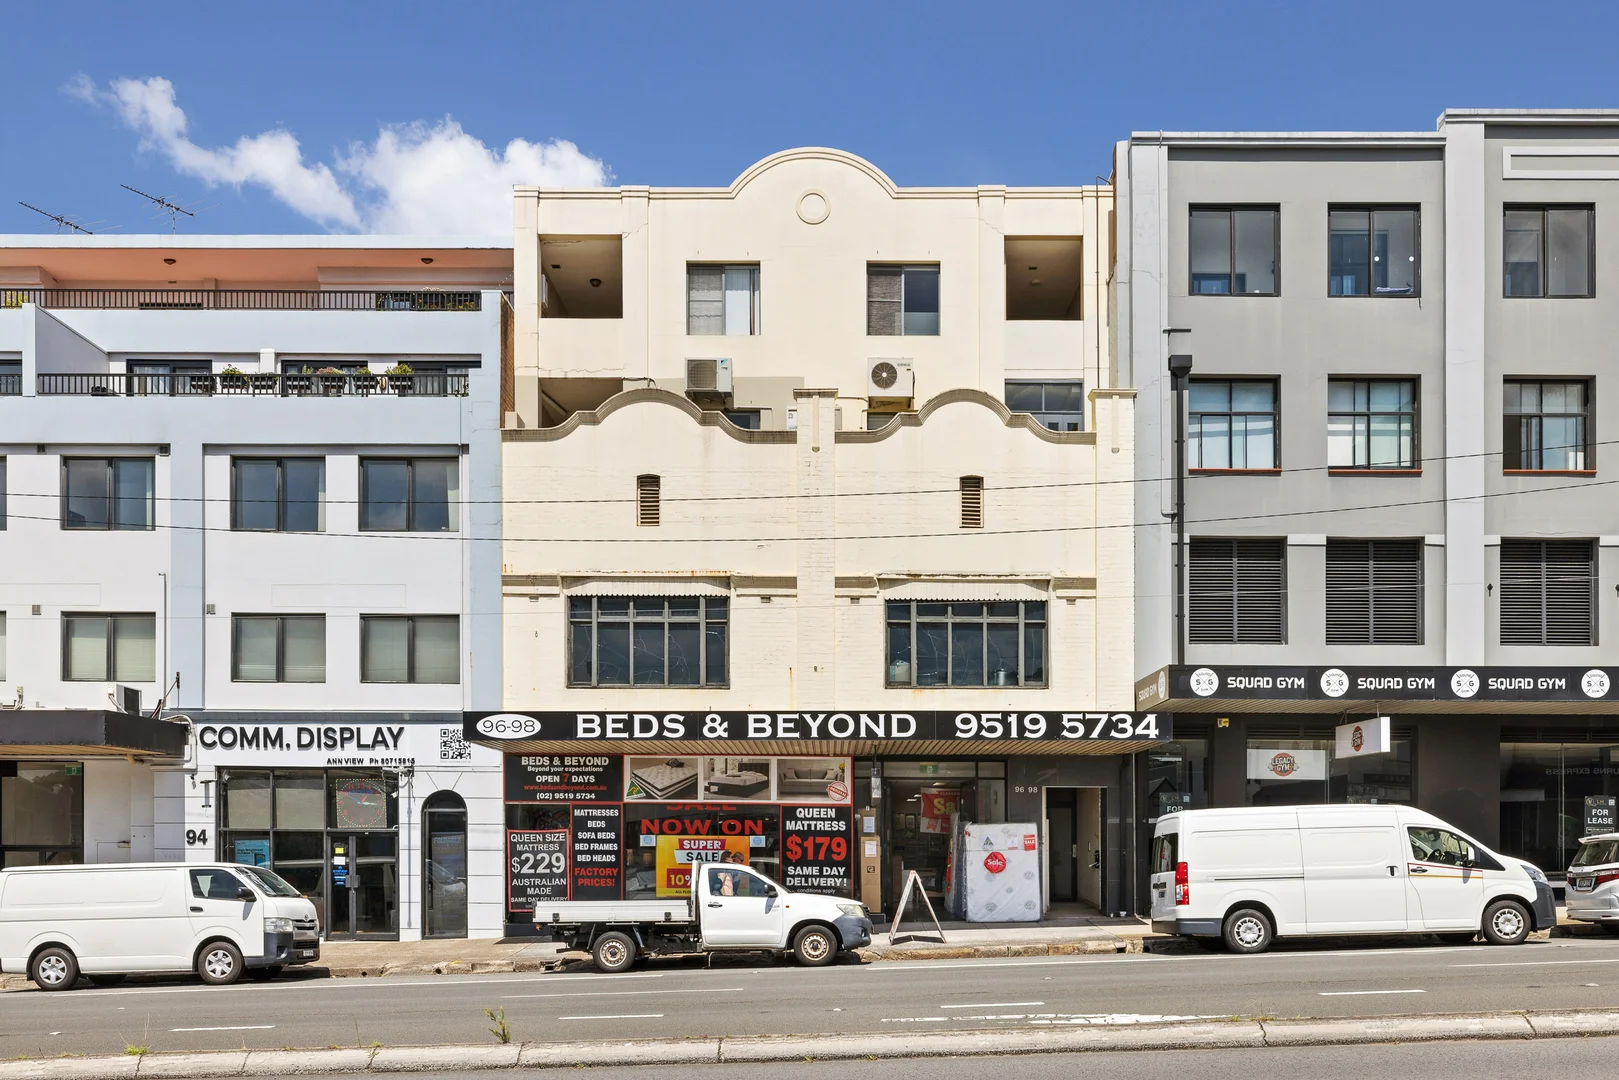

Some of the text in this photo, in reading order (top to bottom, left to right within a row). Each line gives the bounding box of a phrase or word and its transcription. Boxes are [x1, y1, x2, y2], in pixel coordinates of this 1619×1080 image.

[1227, 677, 1304, 689] SQUAD GYM
[1357, 678, 1435, 690] SQUAD GYM
[1488, 678, 1565, 690] SQUAD GYM
[1139, 687, 1149, 701] SQUAD
[482, 720, 535, 732] 96-98
[576, 713, 1158, 738] BEDS & BEYOND 9519 5734
[200, 726, 404, 749] COMM. DISPLAY
[522, 757, 609, 765] BEDS & BEYOND
[1271, 756, 1295, 765] LEGACY
[563, 773, 570, 783] 7
[796, 808, 835, 818] QUEEN
[641, 819, 763, 835] NOW ON
[786, 821, 846, 831] MATTRESS
[186, 829, 208, 846] 94
[510, 833, 565, 842] QUEEN SIZE
[683, 840, 721, 849] SUPER
[786, 834, 847, 862] $179
[686, 852, 718, 862] SALE
[512, 853, 565, 874] $229
[575, 868, 618, 876] FACTORY
[788, 866, 846, 875] SAME DAY
[786, 878, 847, 886] DELIVERY!
